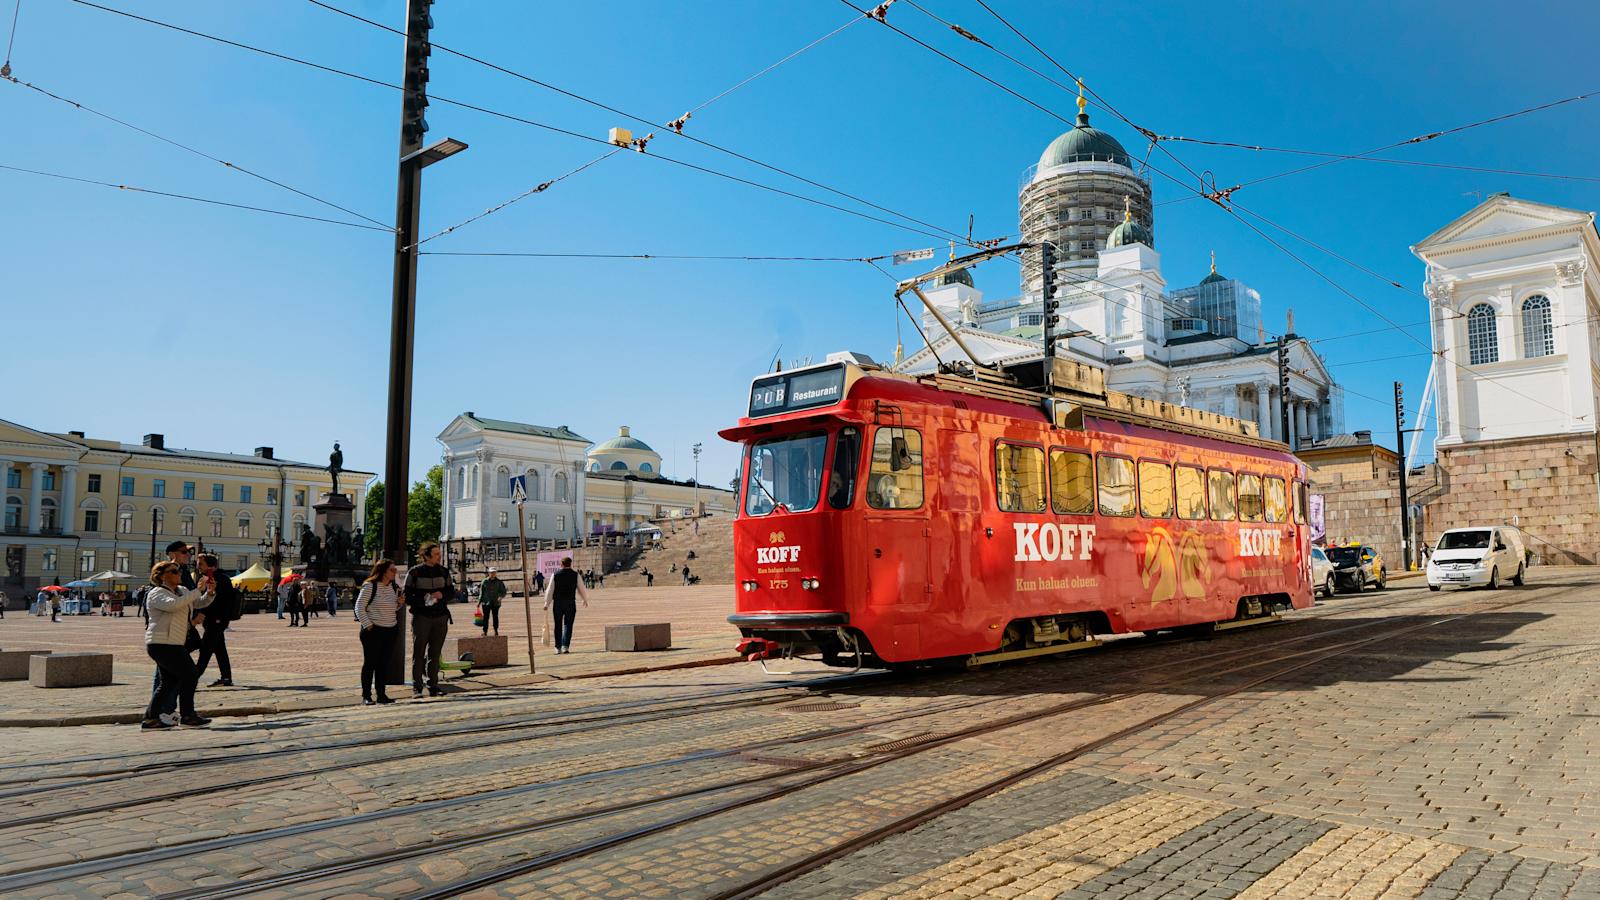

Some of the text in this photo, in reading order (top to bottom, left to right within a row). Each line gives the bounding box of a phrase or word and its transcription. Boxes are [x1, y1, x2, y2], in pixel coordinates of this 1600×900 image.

[754, 388, 785, 406] PUB
[793, 385, 838, 402] Restaurant
[1013, 522, 1096, 562] KOFF
[1239, 528, 1282, 557] KOFF
[757, 545, 801, 564] KOFF
[769, 579, 789, 590] 175
[1015, 575, 1099, 592] Kun haluat oluen.
